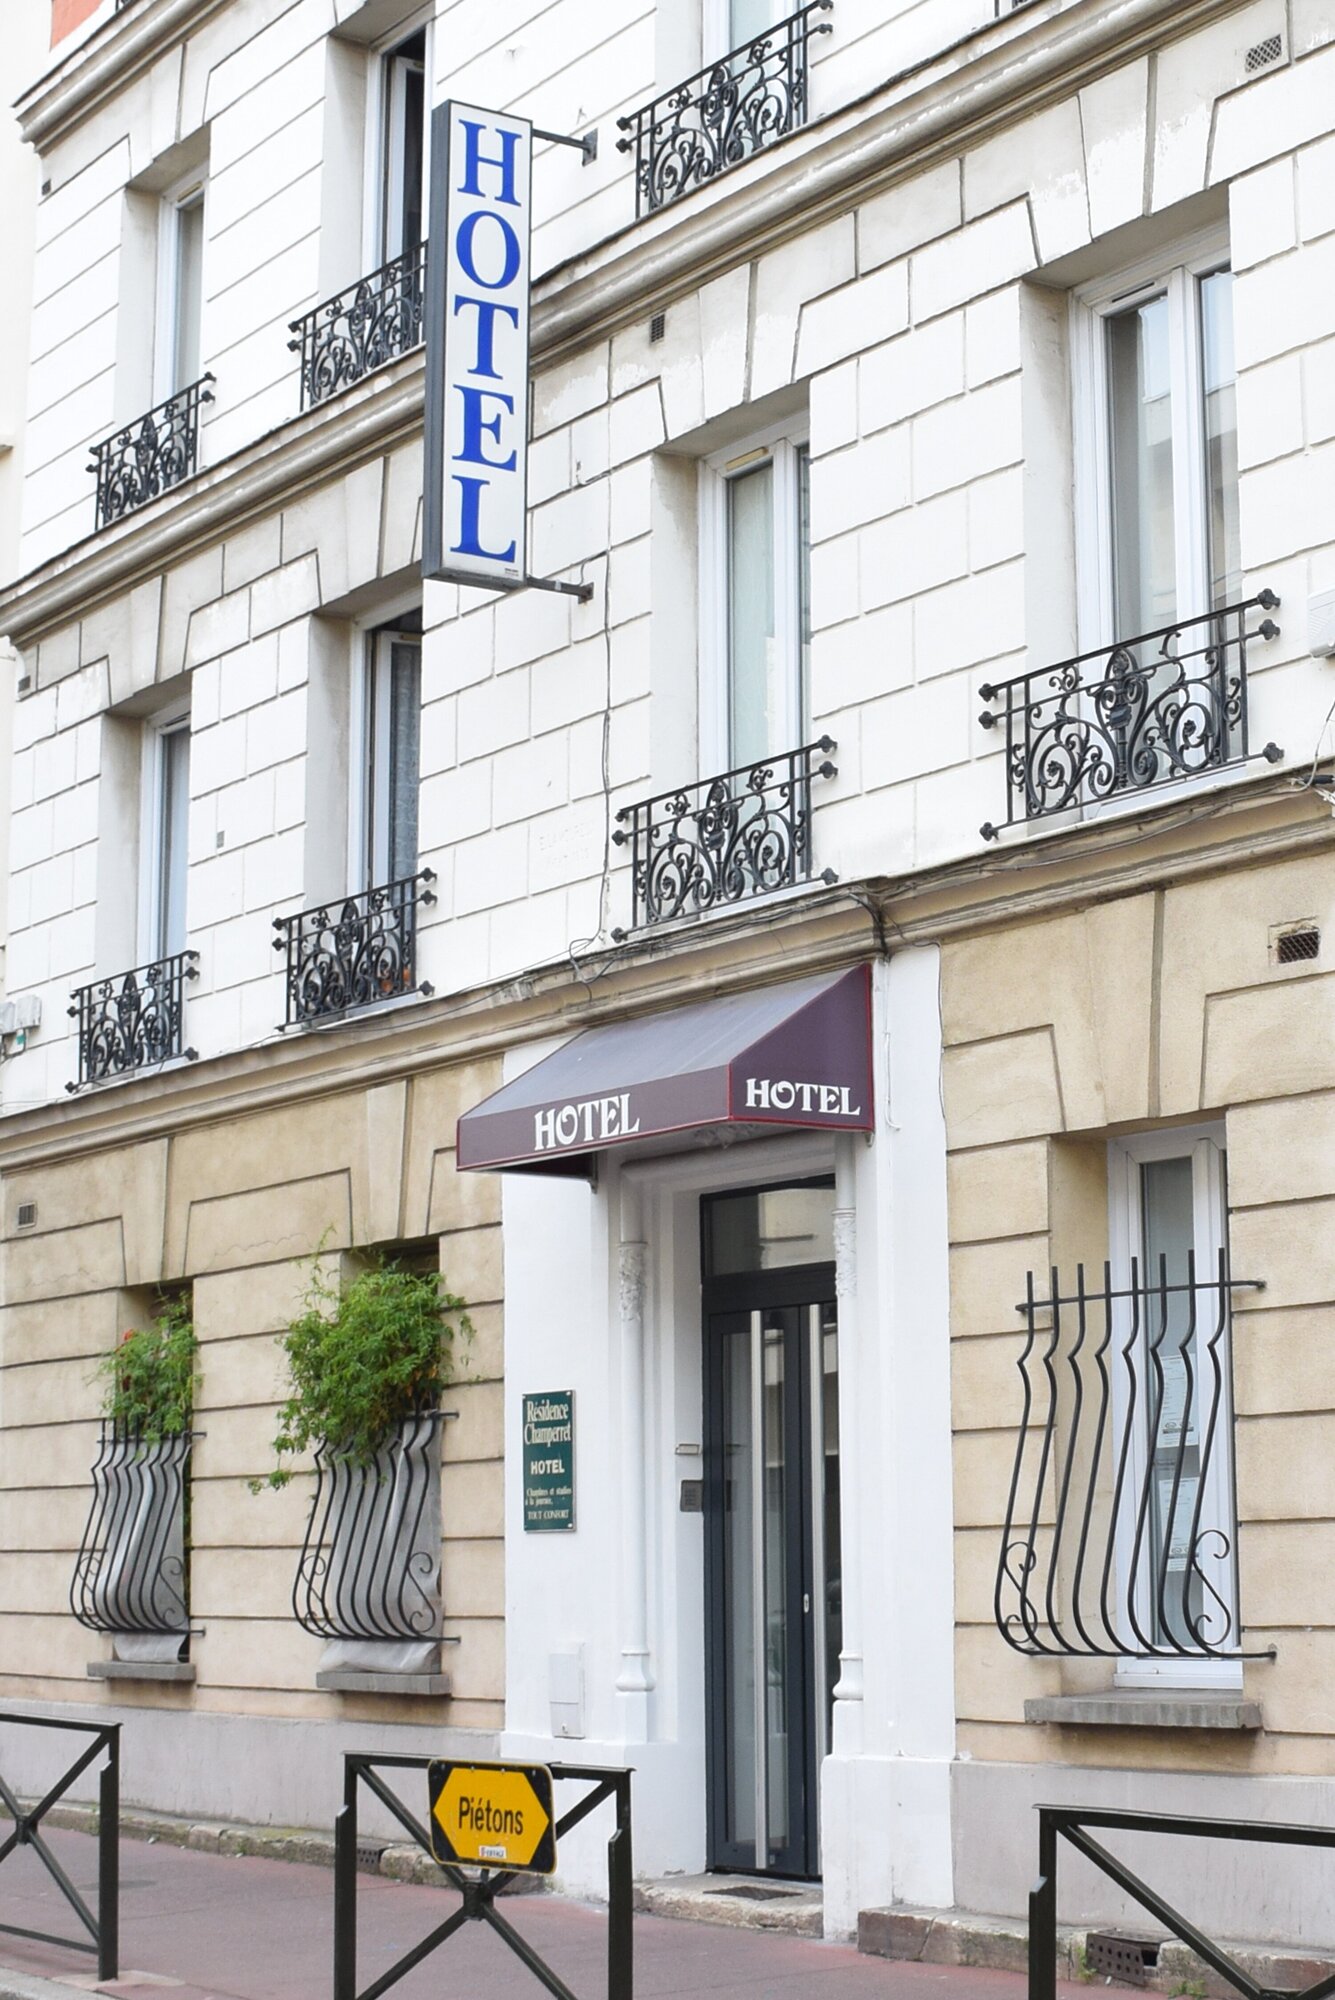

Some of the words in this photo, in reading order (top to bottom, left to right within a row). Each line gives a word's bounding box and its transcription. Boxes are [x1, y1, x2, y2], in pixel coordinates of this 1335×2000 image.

[450, 119, 523, 563] HOTEL
[745, 1078, 861, 1116] HOTEL
[534, 1093, 640, 1151] HOTEL
[527, 1399, 569, 1422] Résidence
[524, 1420, 572, 1448] Champerret
[530, 1459, 565, 1475] HOTEL
[528, 1511, 543, 1520] TOUT
[543, 1509, 569, 1519] CONFORT
[458, 1796, 524, 1836] Piétons
